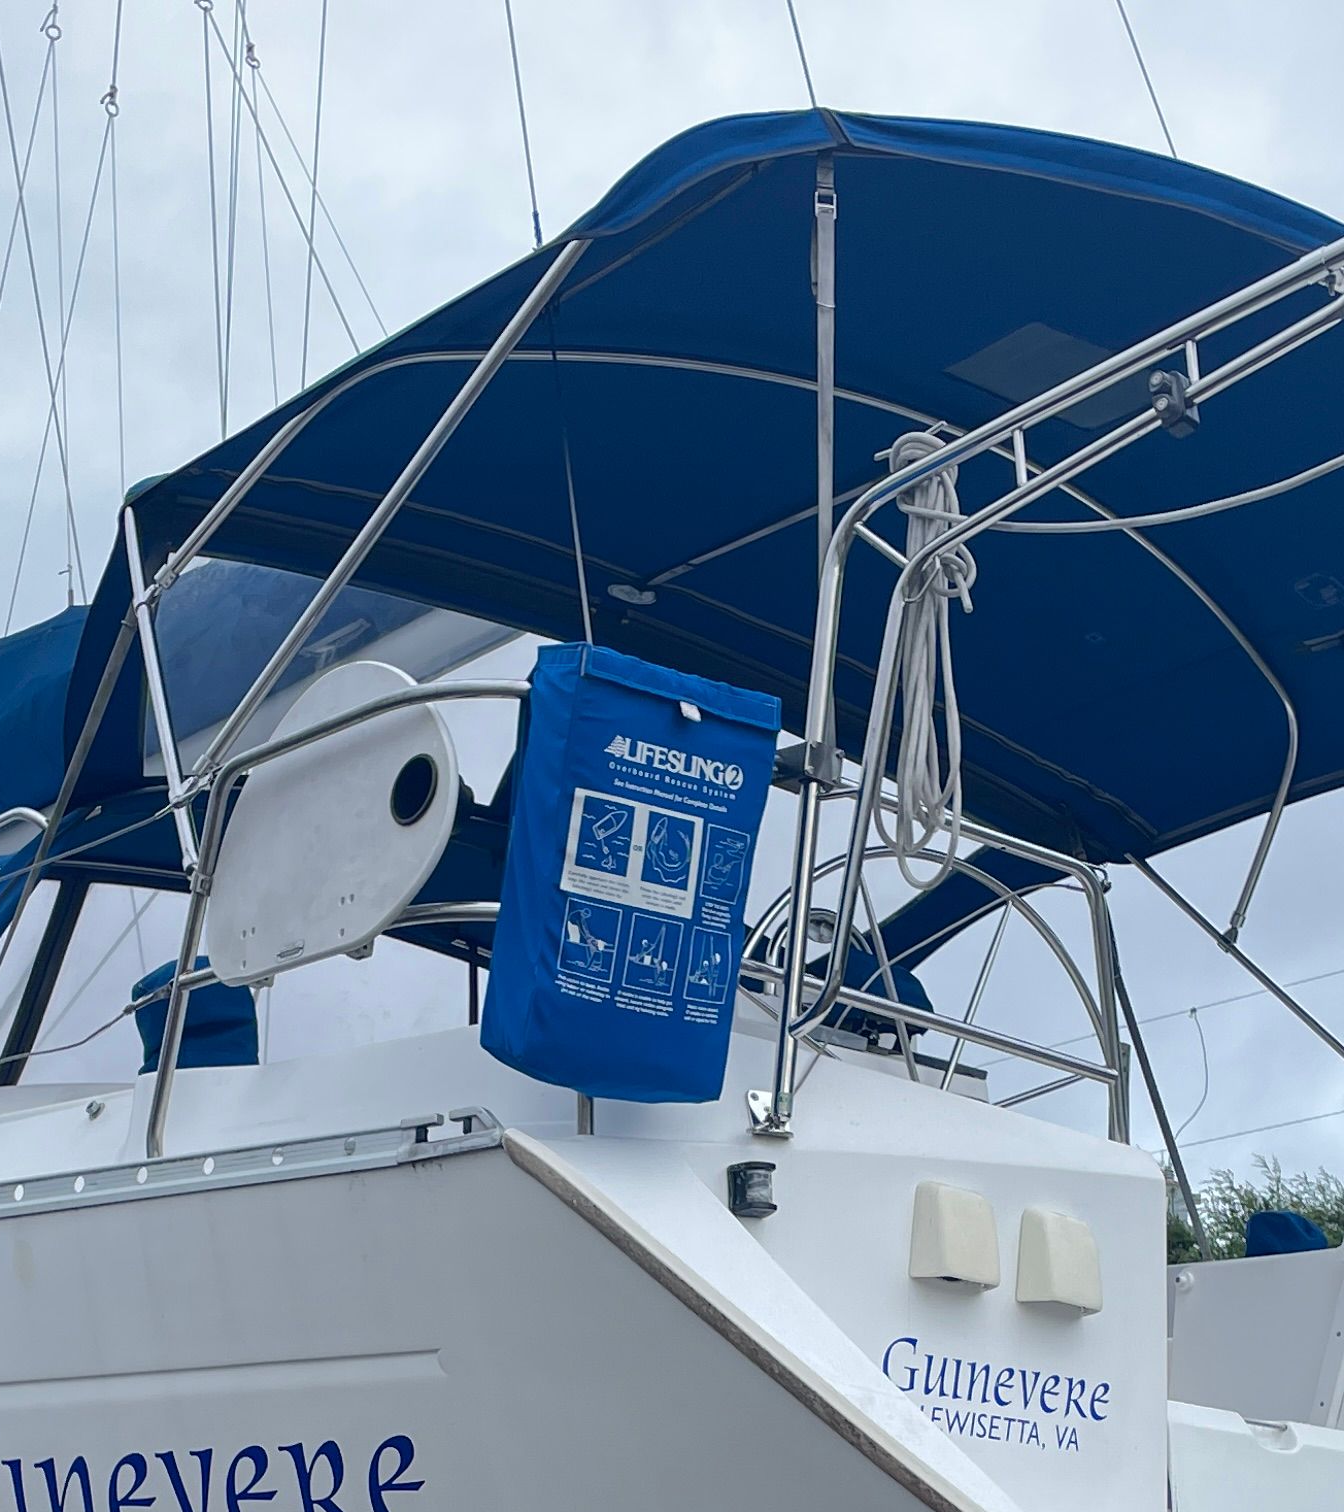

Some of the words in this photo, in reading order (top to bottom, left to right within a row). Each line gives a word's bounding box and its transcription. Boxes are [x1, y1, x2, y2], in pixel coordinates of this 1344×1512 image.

[608, 761, 661, 781] Overboard
[664, 775, 698, 791] Rescue
[702, 785, 736, 801] System
[622, 737, 726, 786] LIFESLING
[920, 1405, 1046, 1450] EWISETTA,
[1055, 1424, 1079, 1452] VA
